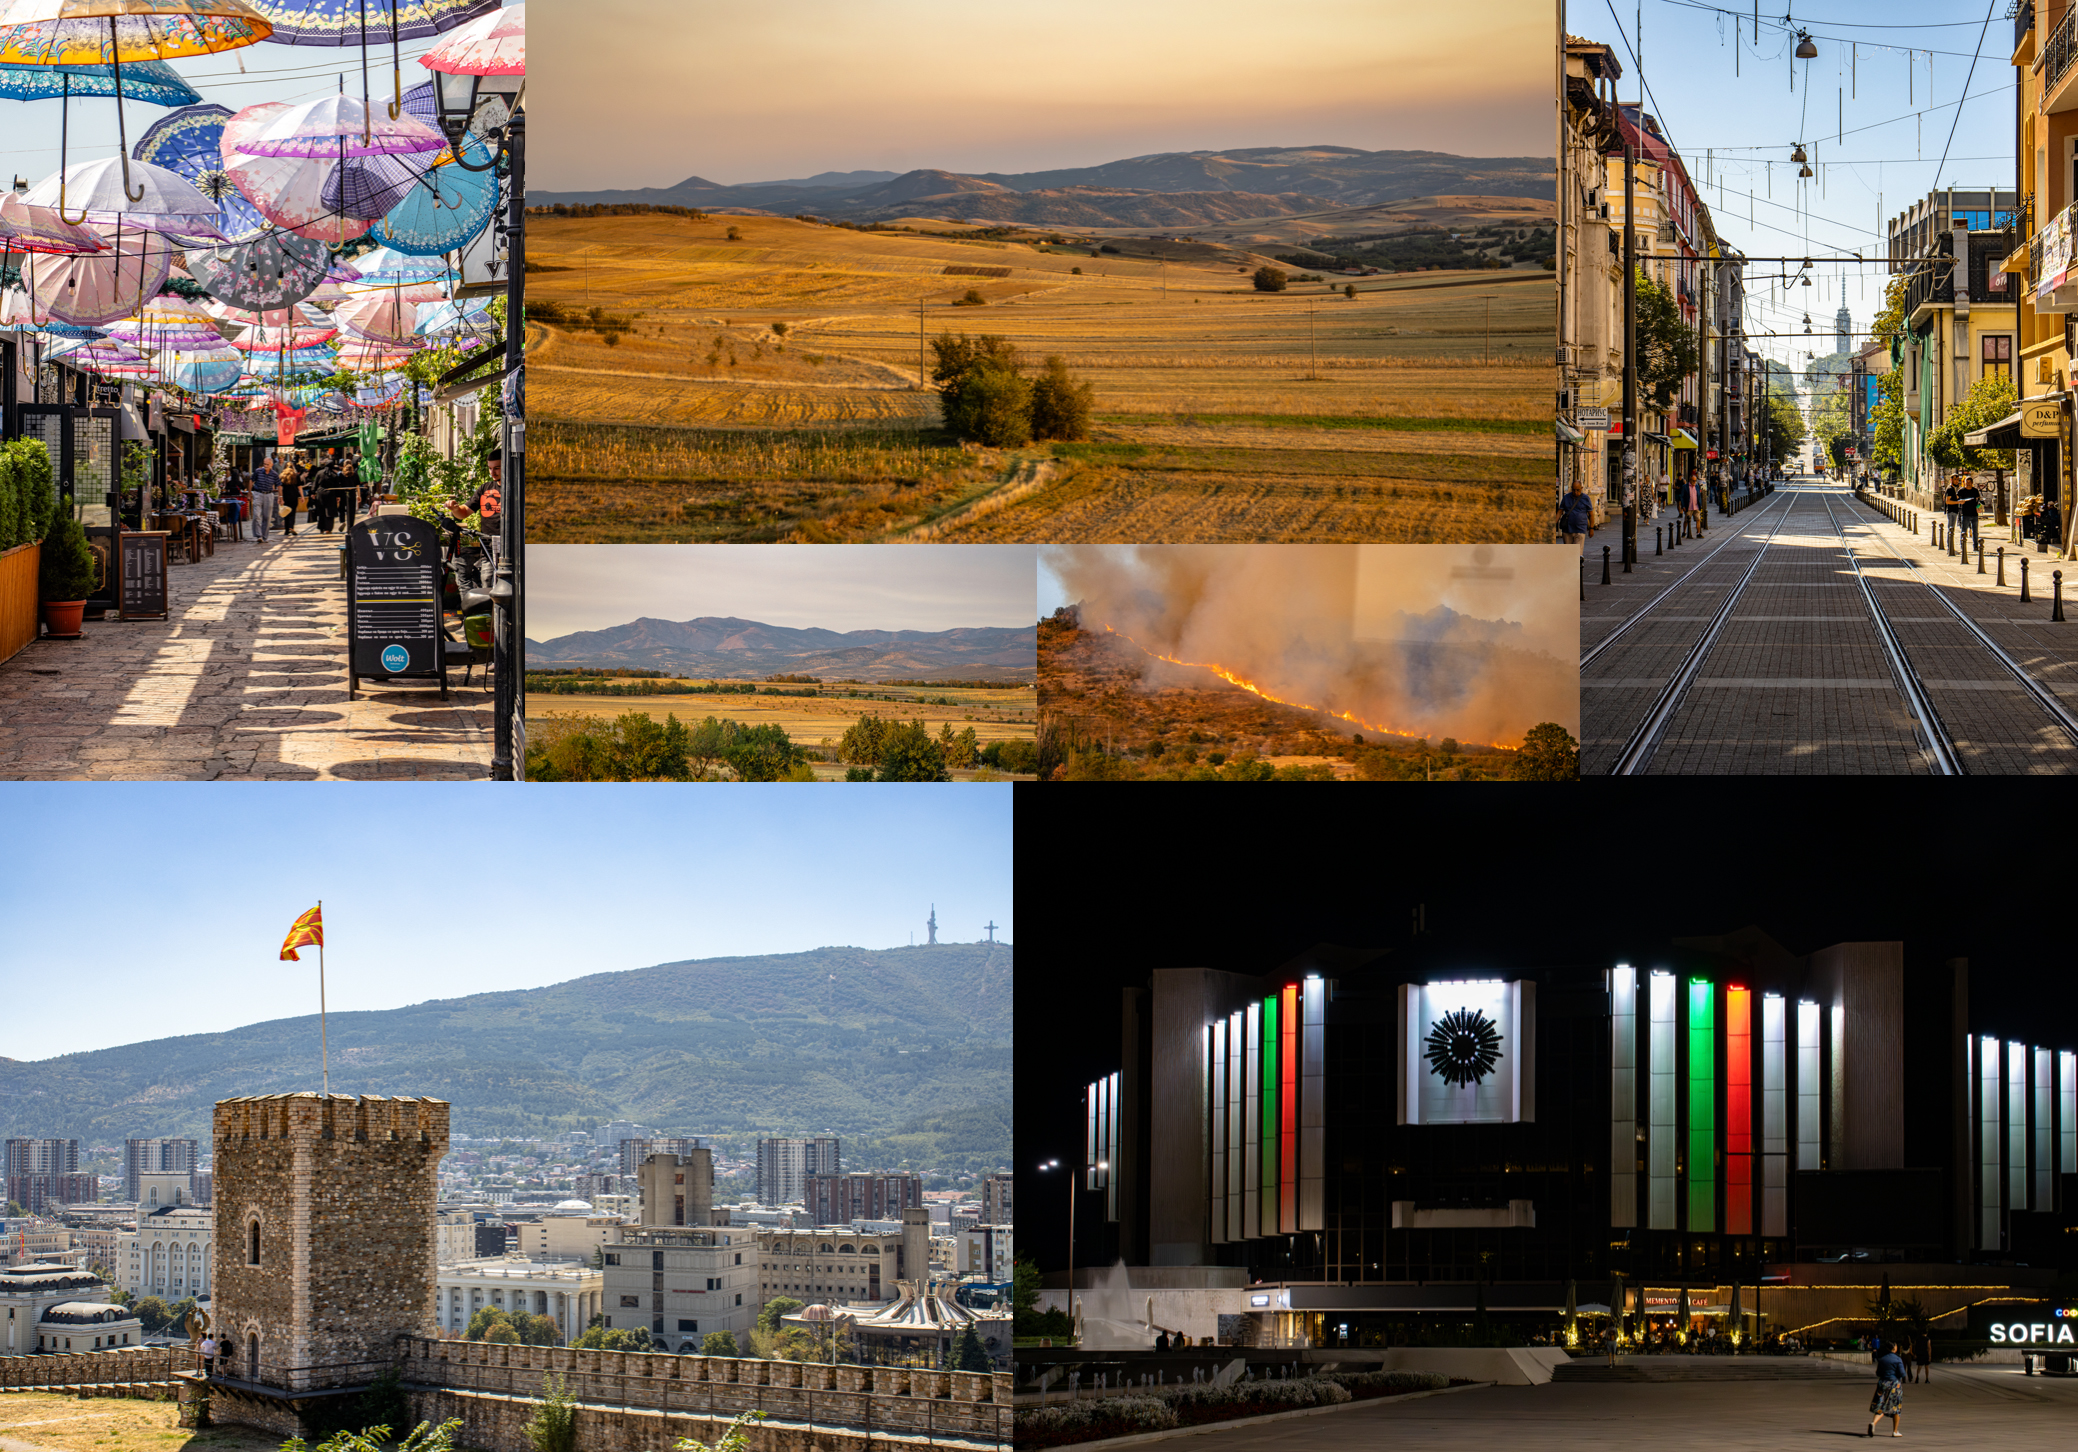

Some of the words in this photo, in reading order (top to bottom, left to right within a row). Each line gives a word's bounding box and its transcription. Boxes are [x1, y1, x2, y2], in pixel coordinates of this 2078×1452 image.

[91, 385, 119, 393] tretto
[1577, 408, 1607, 417] НОТАРИУС
[2036, 410, 2059, 419] D&P
[2063, 415, 2072, 511] ПАРФЮМЕРИЯ
[367, 531, 413, 561] VS
[386, 654, 405, 662] Wolt
[1646, 1297, 1677, 1305] MEMENTO
[1692, 1297, 1708, 1306] CAFÉ
[1990, 1323, 2075, 1343] SOFIA
